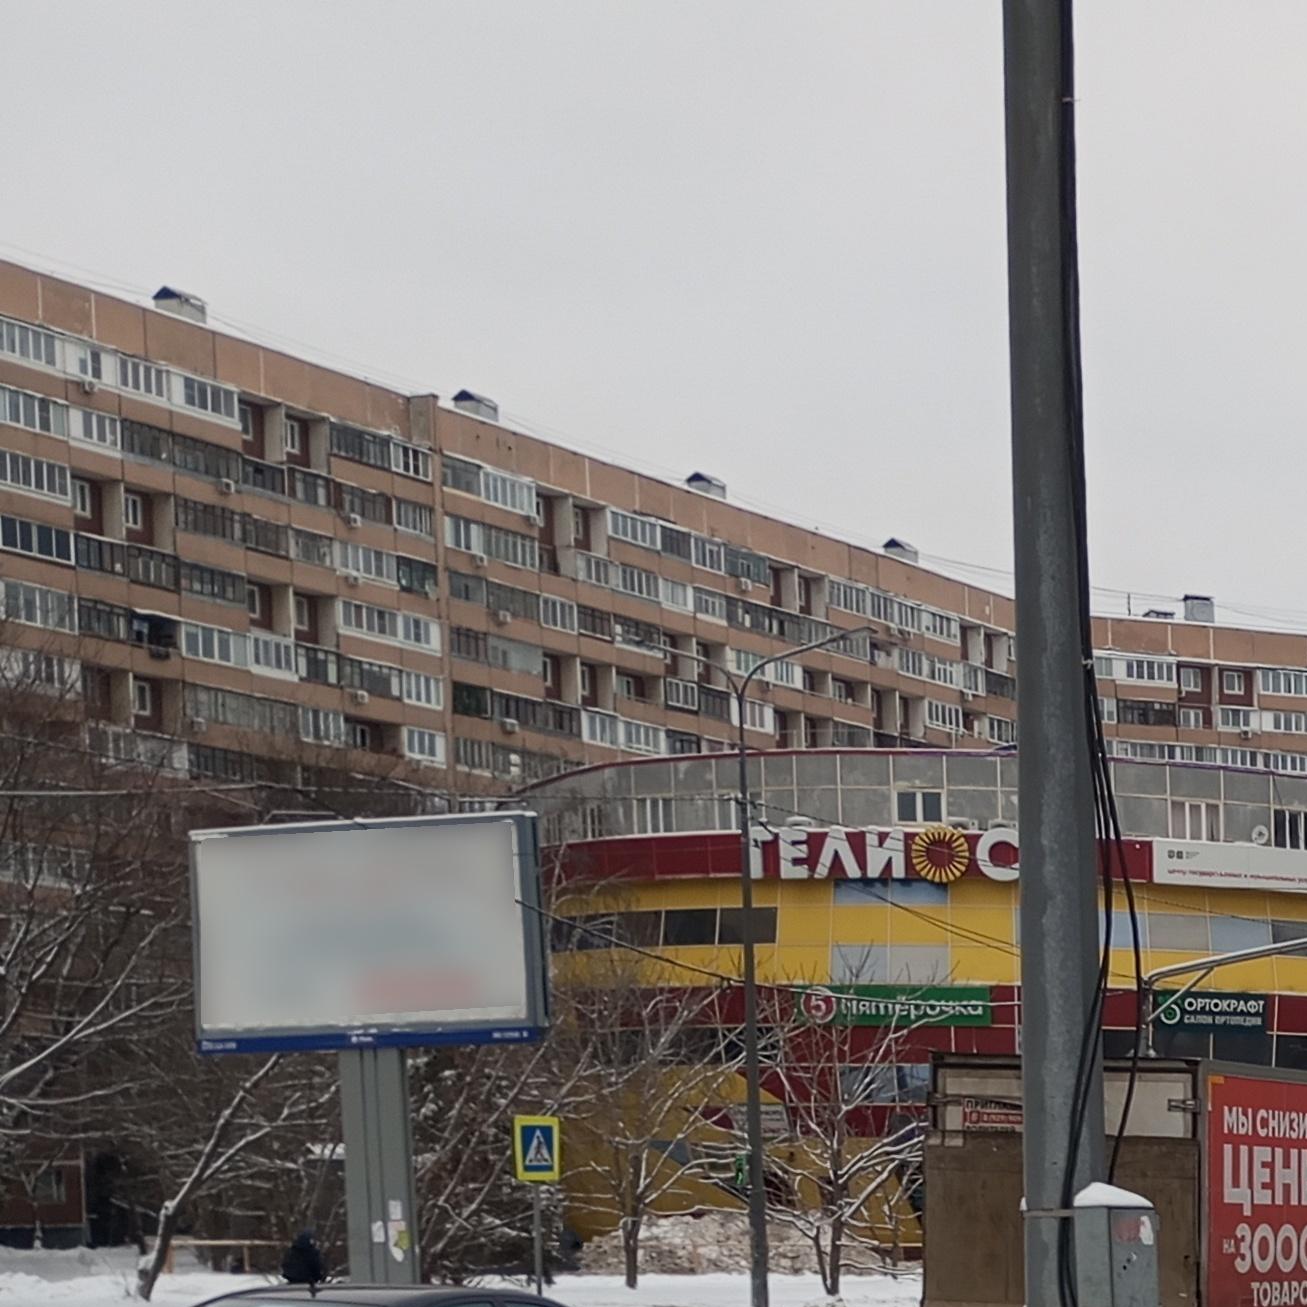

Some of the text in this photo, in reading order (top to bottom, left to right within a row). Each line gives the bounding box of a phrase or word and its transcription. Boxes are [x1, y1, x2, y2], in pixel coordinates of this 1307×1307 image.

[1184, 997, 1265, 1014] ОРТОКРАФТ
[1183, 1015, 1213, 1025] САЛОН
[1223, 1105, 1253, 1136] МЫ
[1222, 1238, 1236, 1254] НА
